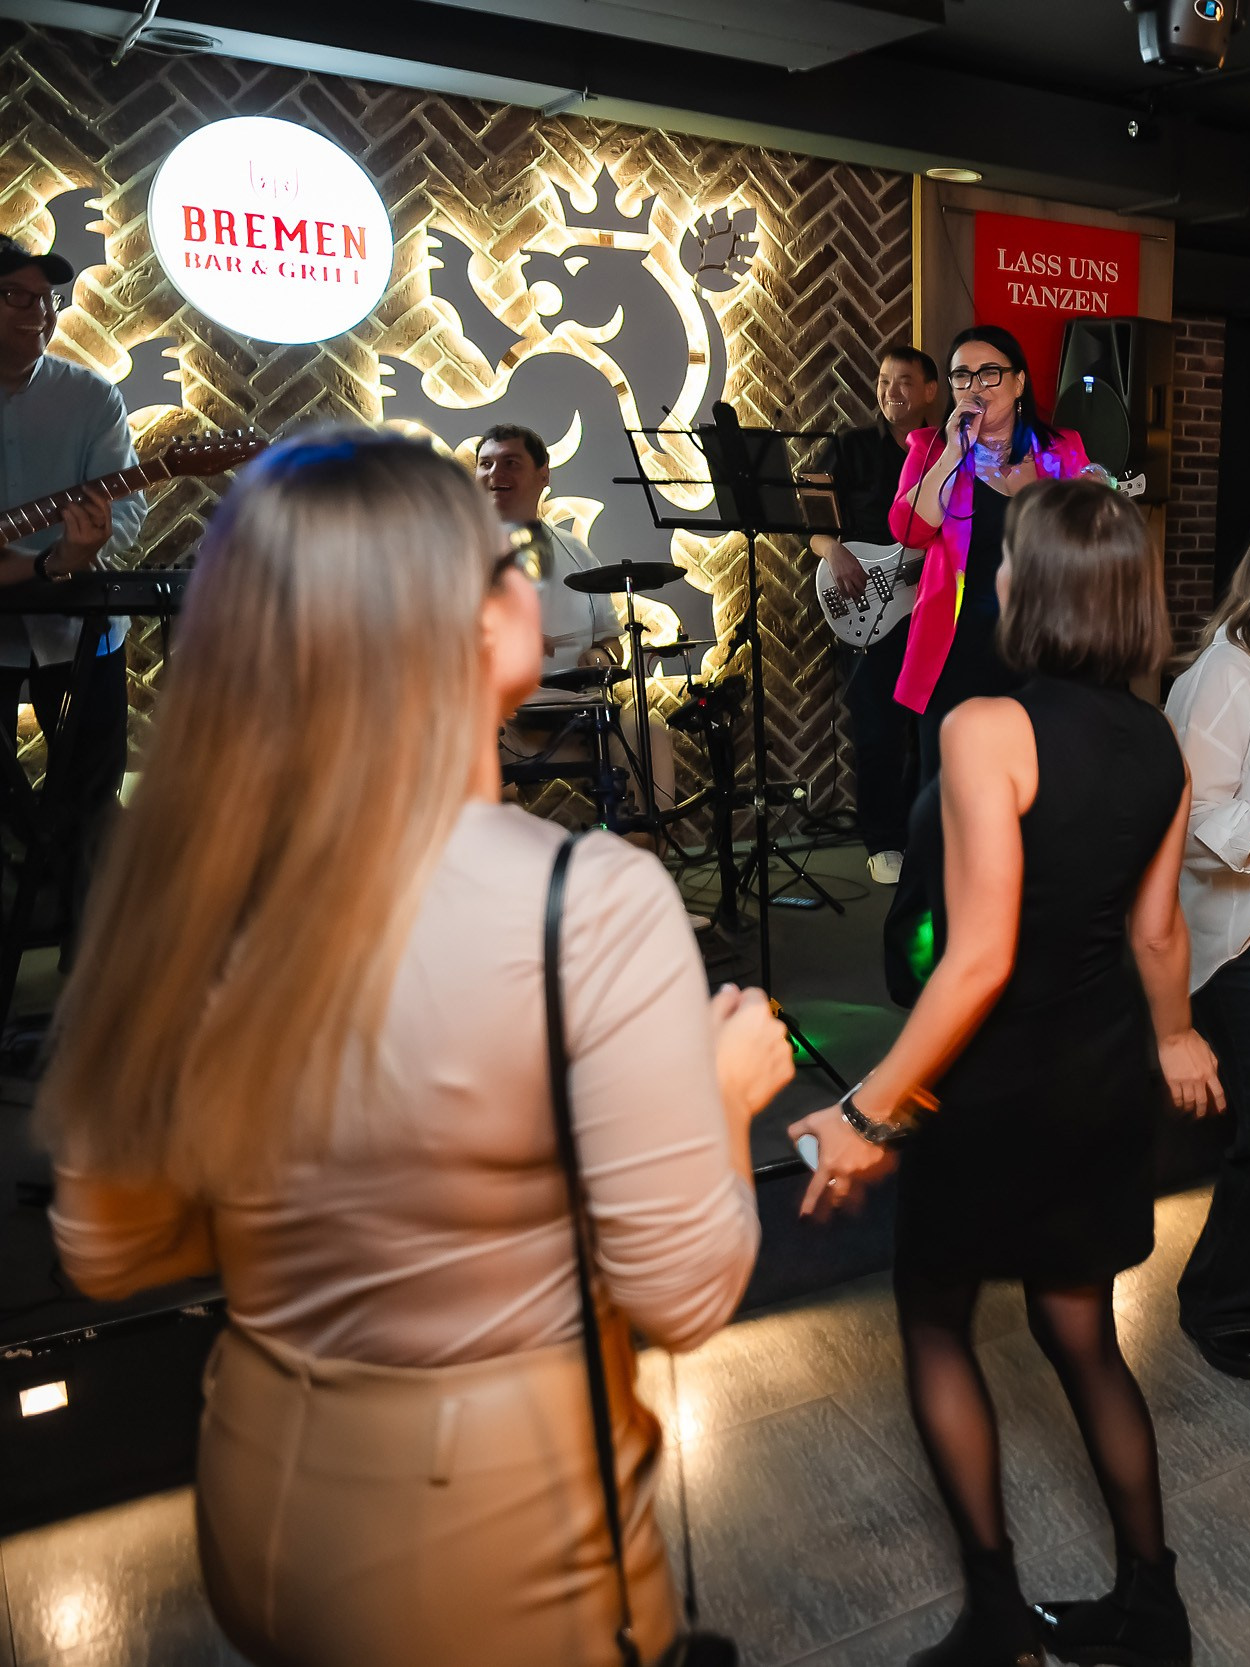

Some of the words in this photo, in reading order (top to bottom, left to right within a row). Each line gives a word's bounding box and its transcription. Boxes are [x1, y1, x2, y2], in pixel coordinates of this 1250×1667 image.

[182, 205, 367, 259] BREMEN
[184, 252, 242, 273] BAR
[251, 259, 268, 275] &
[997, 248, 1061, 276] LASS
[1069, 257, 1119, 283] UNS
[1007, 282, 1109, 314] TANZEN
